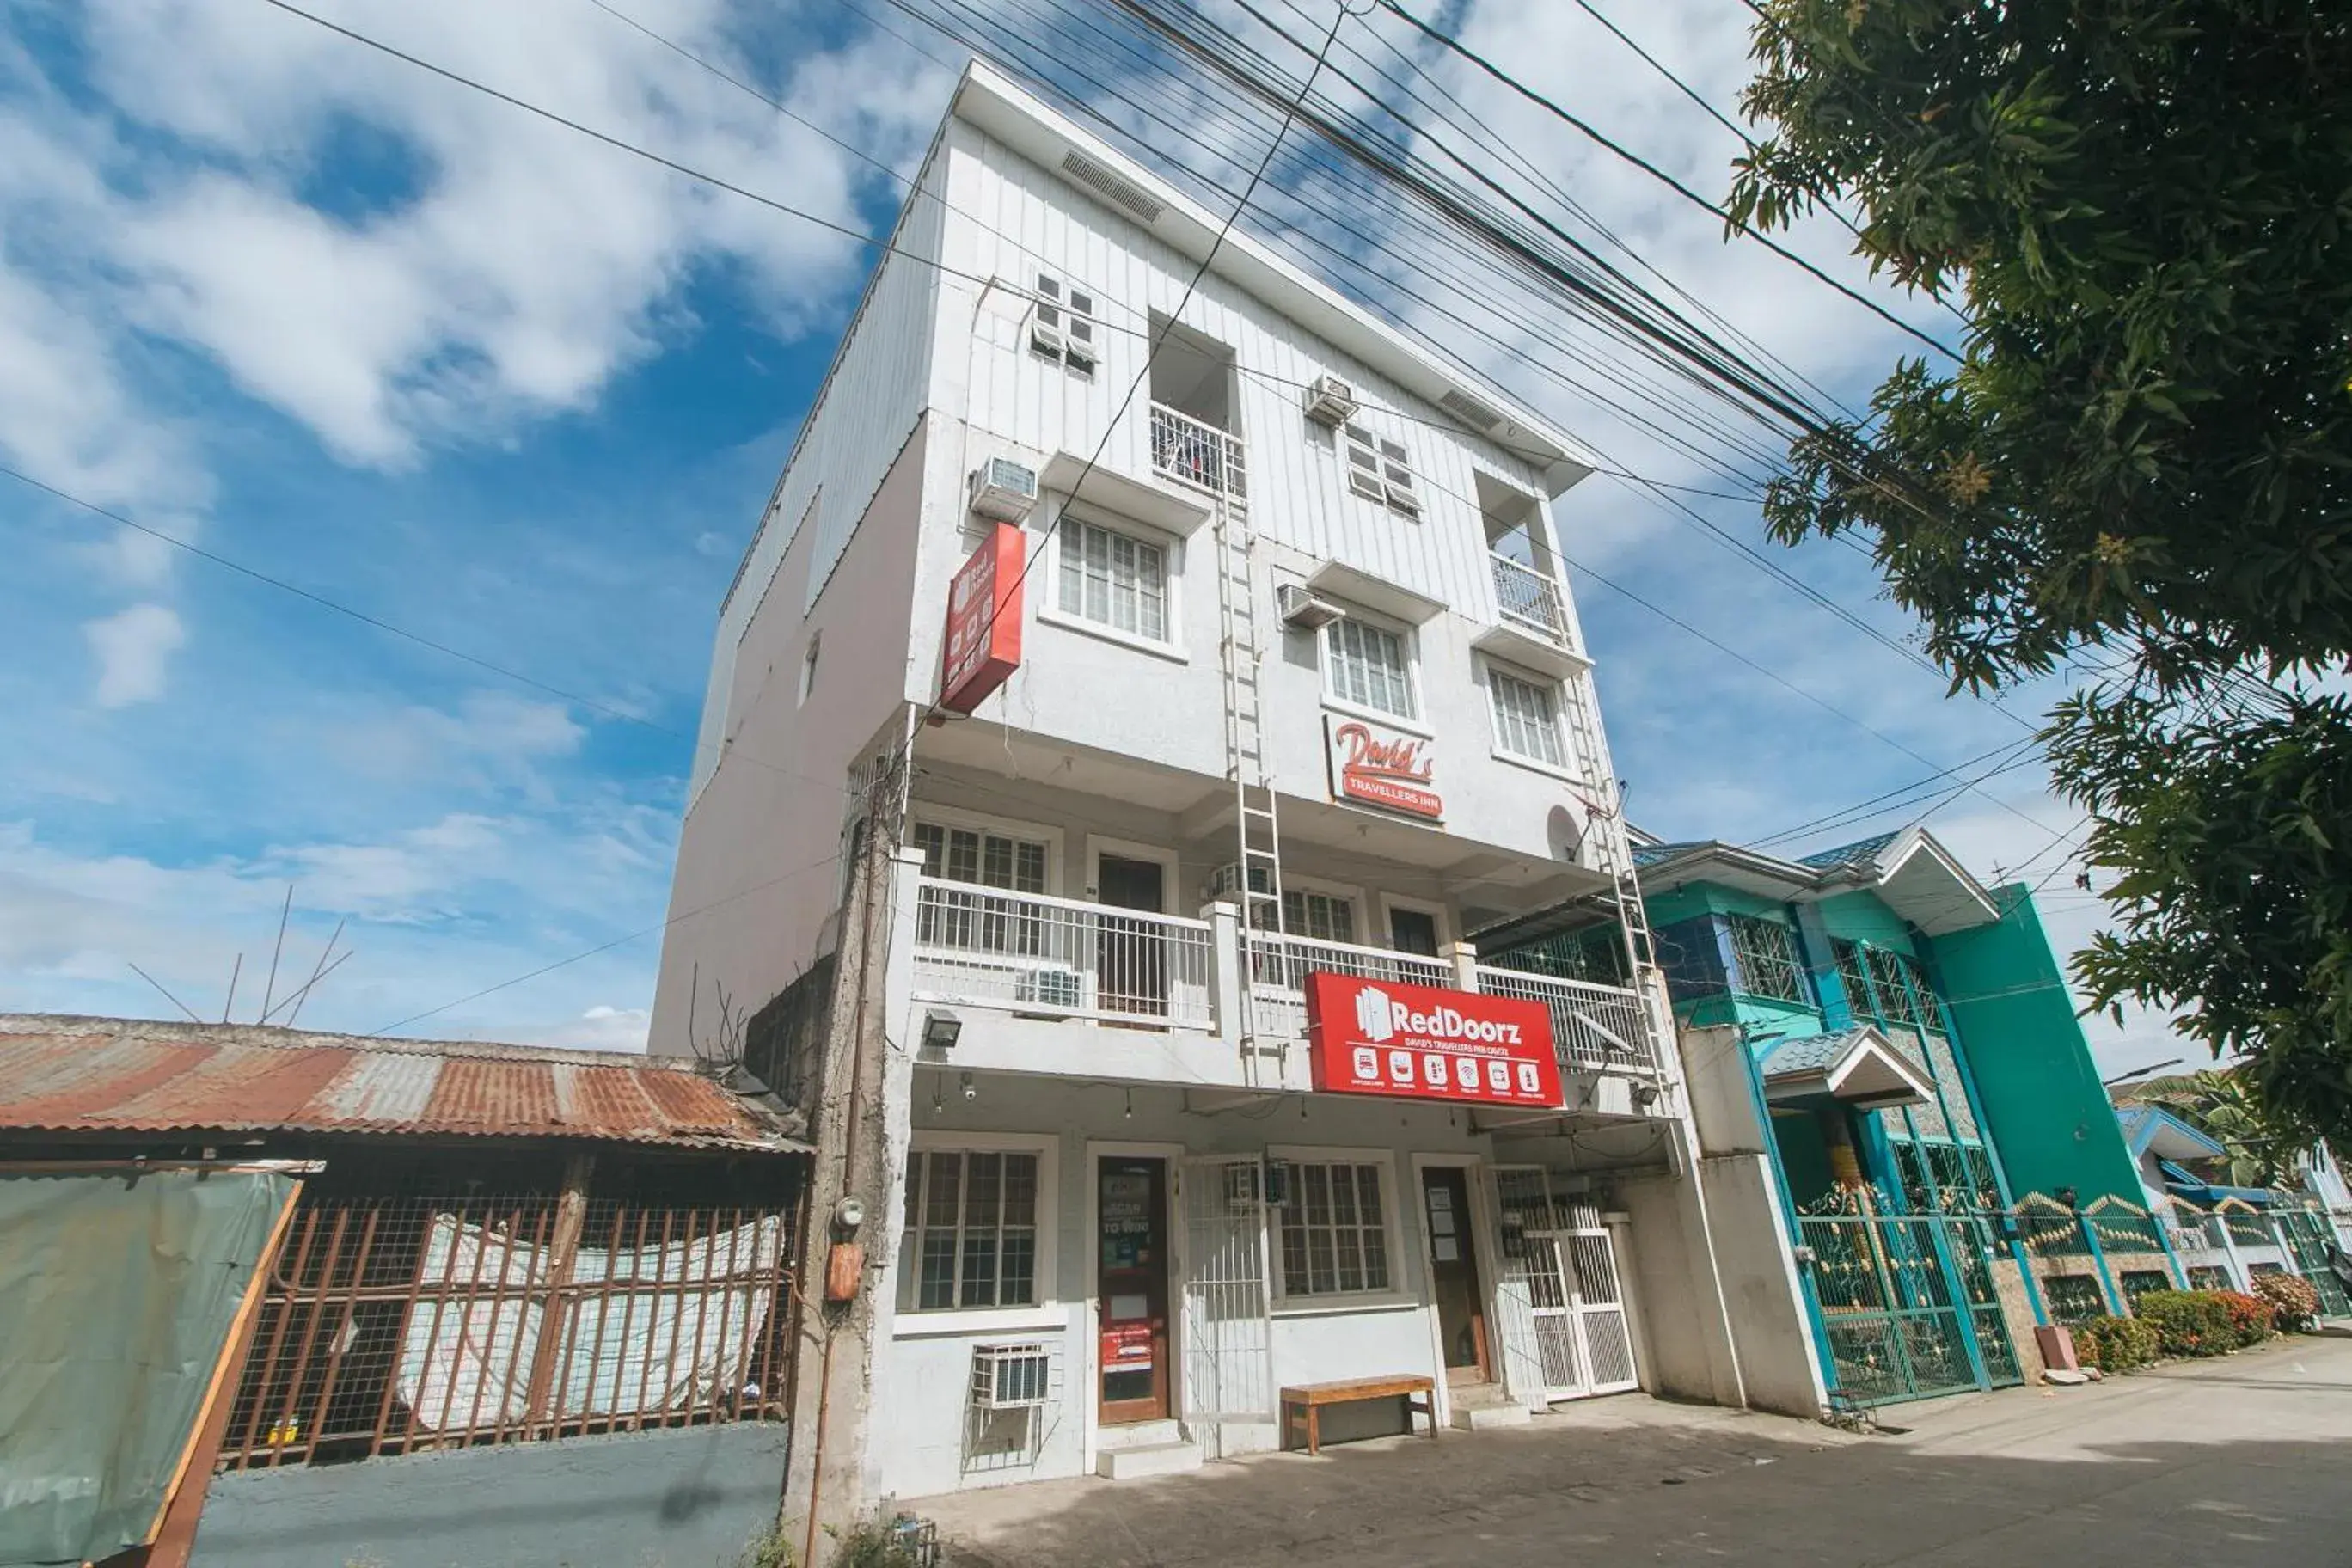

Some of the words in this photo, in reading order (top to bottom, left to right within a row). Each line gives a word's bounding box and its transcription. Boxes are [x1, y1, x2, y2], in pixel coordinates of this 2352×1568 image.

[1336, 722, 1434, 781] David's
[1350, 777, 1418, 804] TRAVELLERS
[1419, 798, 1439, 809] INN
[1392, 1001, 1522, 1044] RedDoorz
